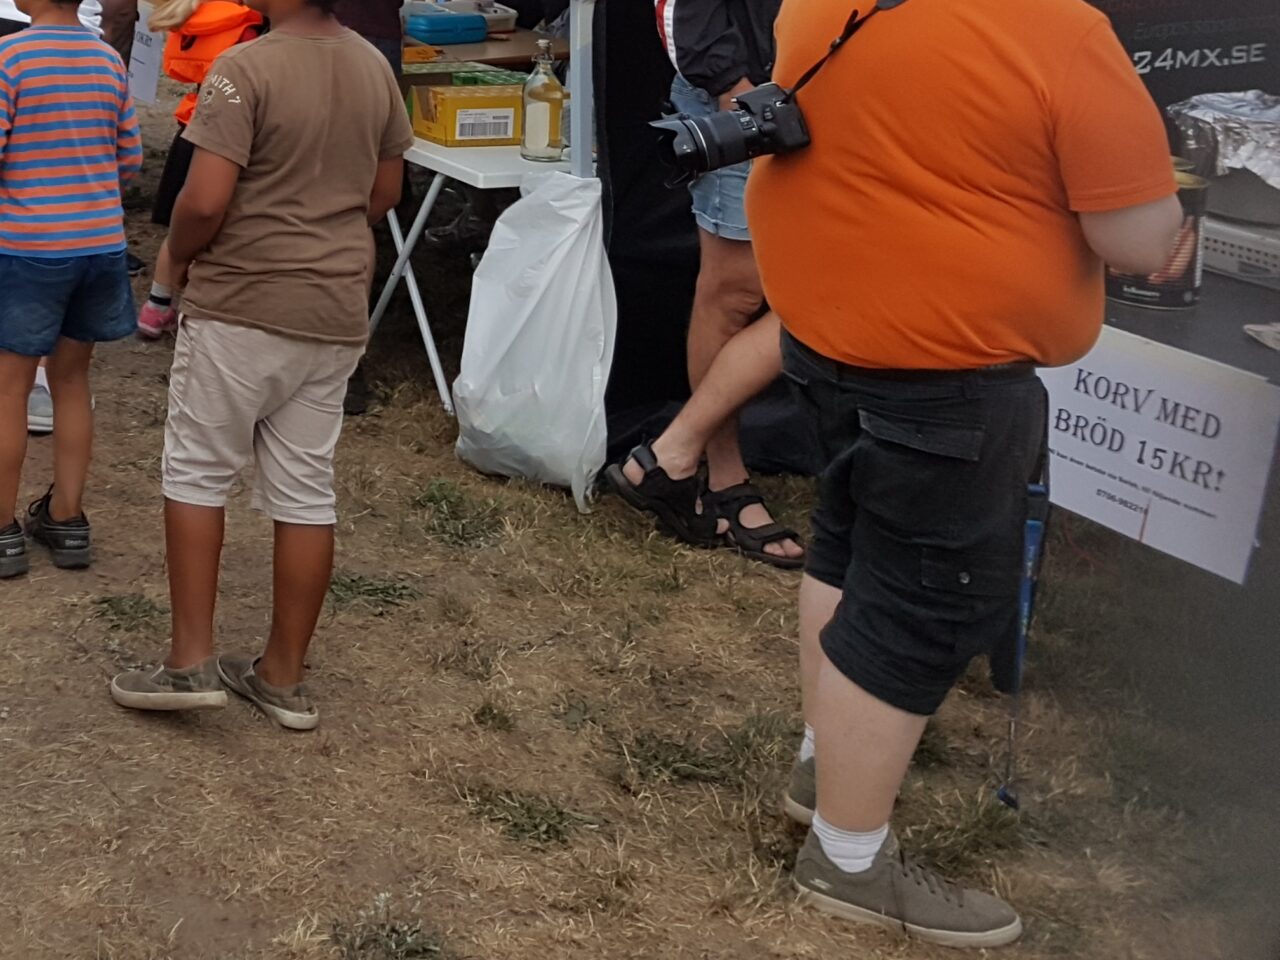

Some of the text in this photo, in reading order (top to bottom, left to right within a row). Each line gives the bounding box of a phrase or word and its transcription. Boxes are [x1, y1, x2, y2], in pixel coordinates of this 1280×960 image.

[1133, 42, 1267, 75] 24MX.SE
[1073, 368, 1222, 440] KORV MED
[1053, 407, 1126, 453] BRÖD
